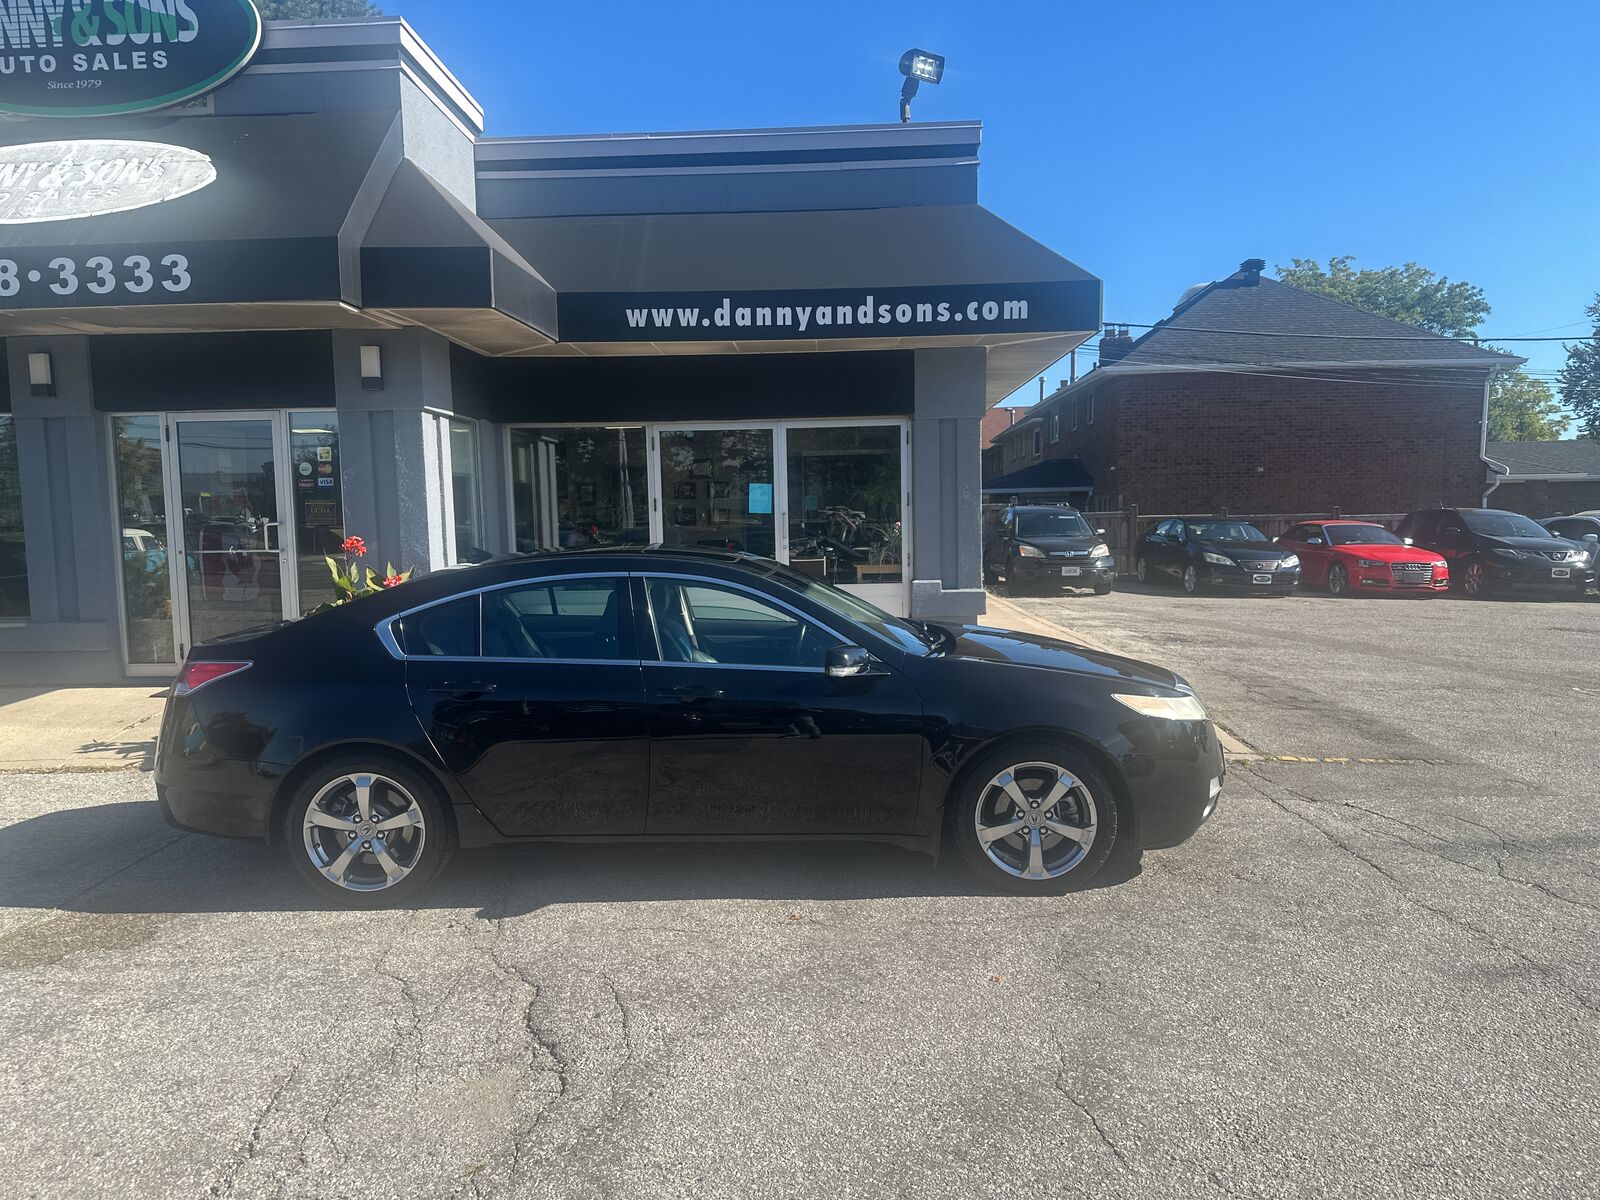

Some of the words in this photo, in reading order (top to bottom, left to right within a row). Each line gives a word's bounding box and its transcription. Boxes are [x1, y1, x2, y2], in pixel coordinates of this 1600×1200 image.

[103, 0, 199, 45] SONS
[72, 50, 169, 71] SALES
[47, 80, 74, 89] Since
[75, 79, 102, 89] 1979
[625, 295, 1029, 331] www.dannyandsons.com
